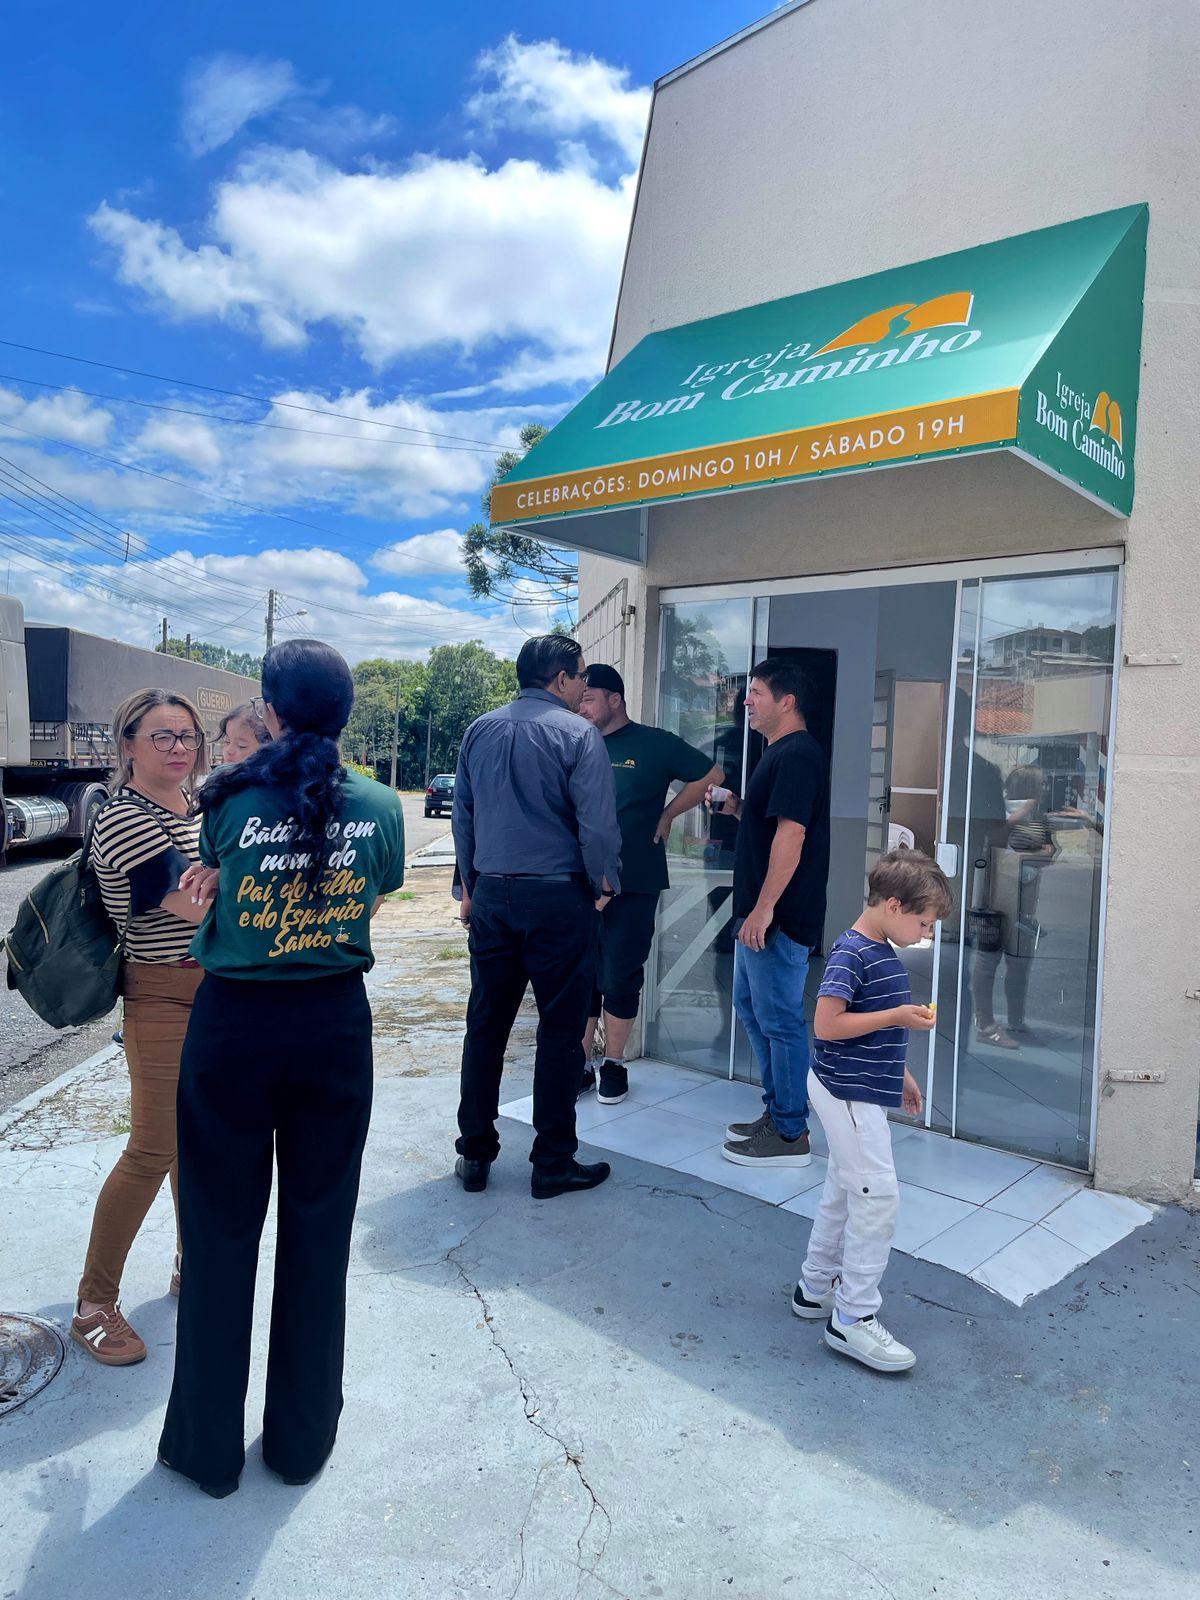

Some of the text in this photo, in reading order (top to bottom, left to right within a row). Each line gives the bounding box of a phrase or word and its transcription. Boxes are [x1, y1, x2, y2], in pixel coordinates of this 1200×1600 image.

[593, 330, 982, 430] Bom Caminho
[680, 343, 811, 388] Igreja
[1056, 371, 1090, 420] Igreja
[1036, 390, 1125, 480] Bom Caminho
[516, 415, 964, 509] CELEBRAÇÕES: DOMINGO 10H / SÁBADO 19H
[200, 691, 230, 710] GUERRA
[343, 821, 376, 838] em
[260, 840, 357, 872] nom do
[237, 875, 279, 903] Pai
[280, 872, 307, 899] do
[239, 911, 250, 927] e
[253, 898, 278, 930] do
[268, 921, 332, 957] Santo
